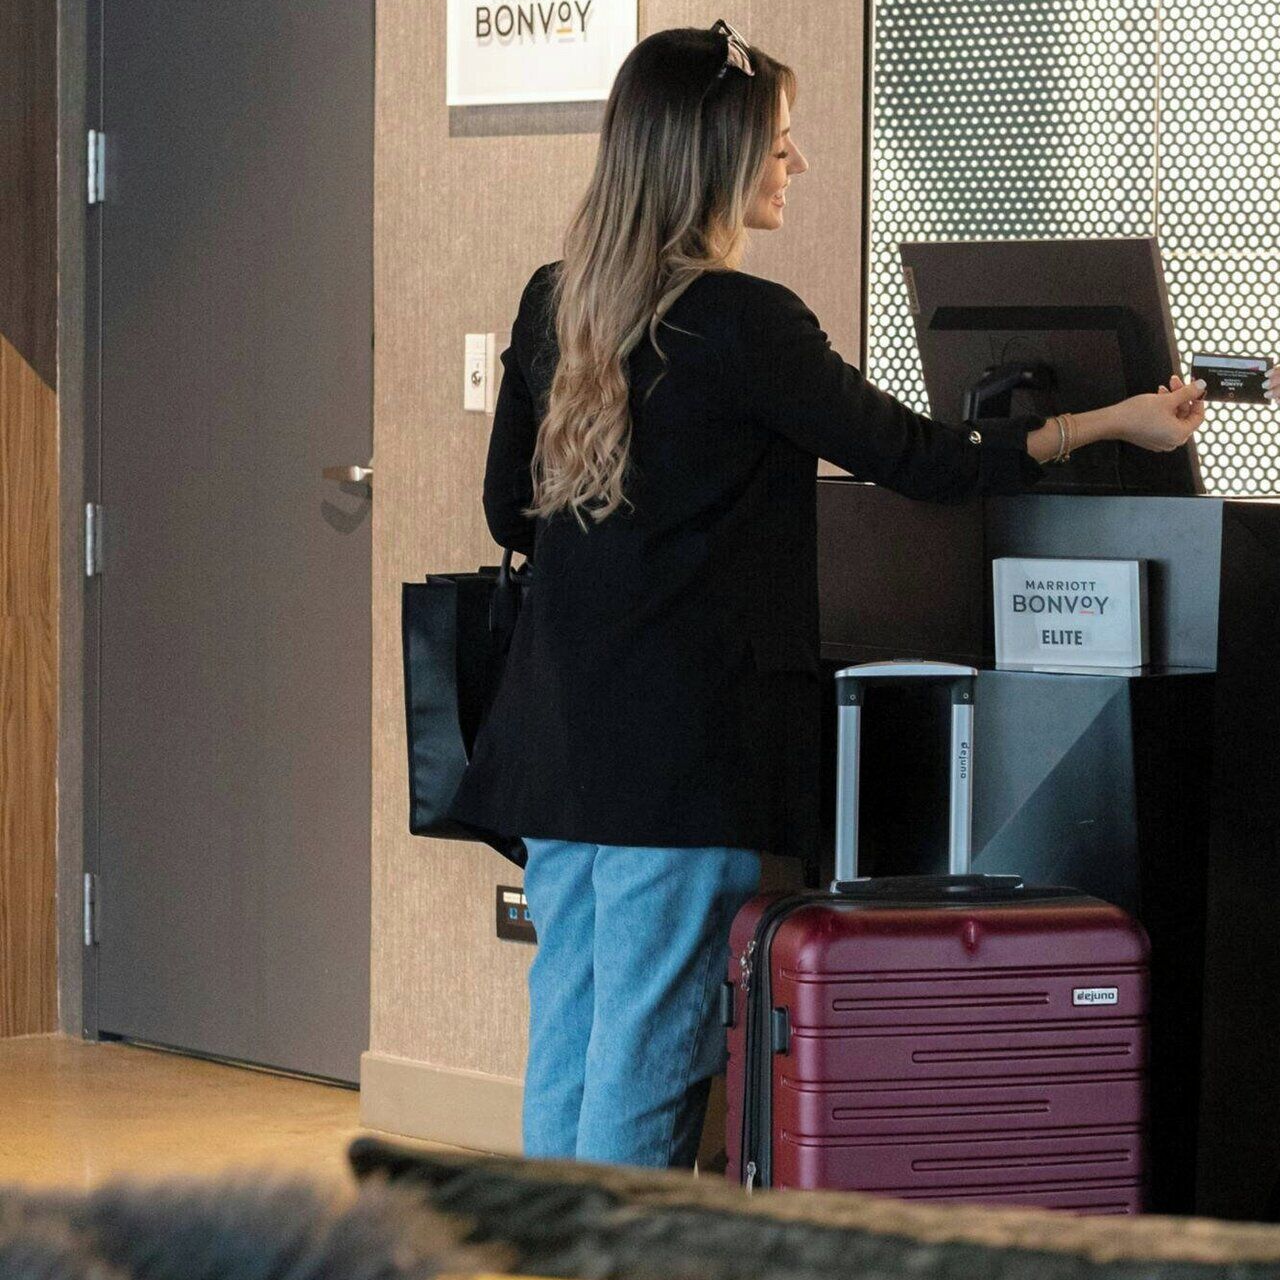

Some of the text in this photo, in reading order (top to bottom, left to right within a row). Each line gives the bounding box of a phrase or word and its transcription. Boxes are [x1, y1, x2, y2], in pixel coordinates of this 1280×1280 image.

[1025, 580, 1096, 591] MARRIOTT
[1042, 629, 1083, 646] ELITE
[959, 742, 970, 779] dejuno
[1077, 991, 1115, 1002] dejuno
